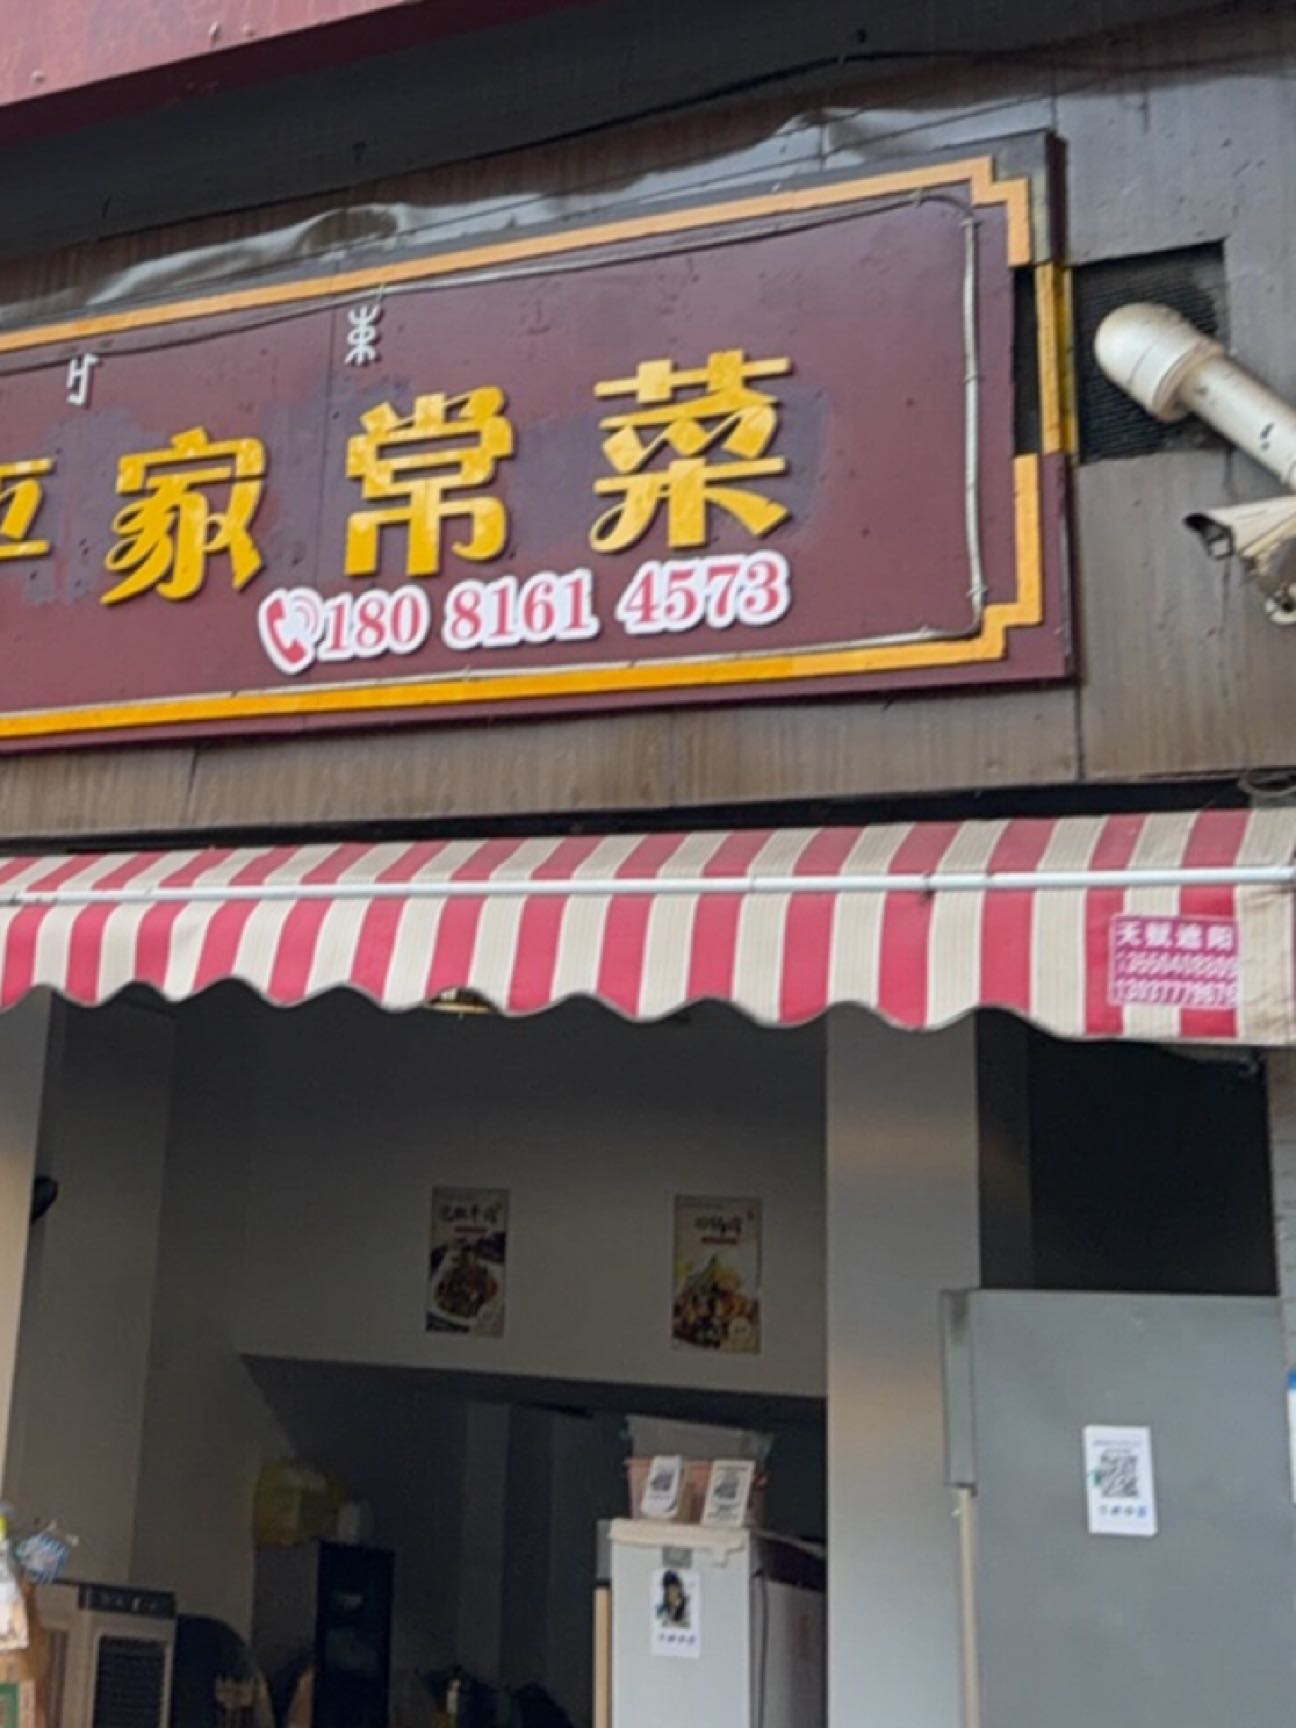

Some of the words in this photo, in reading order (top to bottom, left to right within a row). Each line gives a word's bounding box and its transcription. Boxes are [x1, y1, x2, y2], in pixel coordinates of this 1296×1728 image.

[320, 590, 426, 653] 180
[450, 574, 594, 640] 8161
[623, 558, 782, 624] 4573
